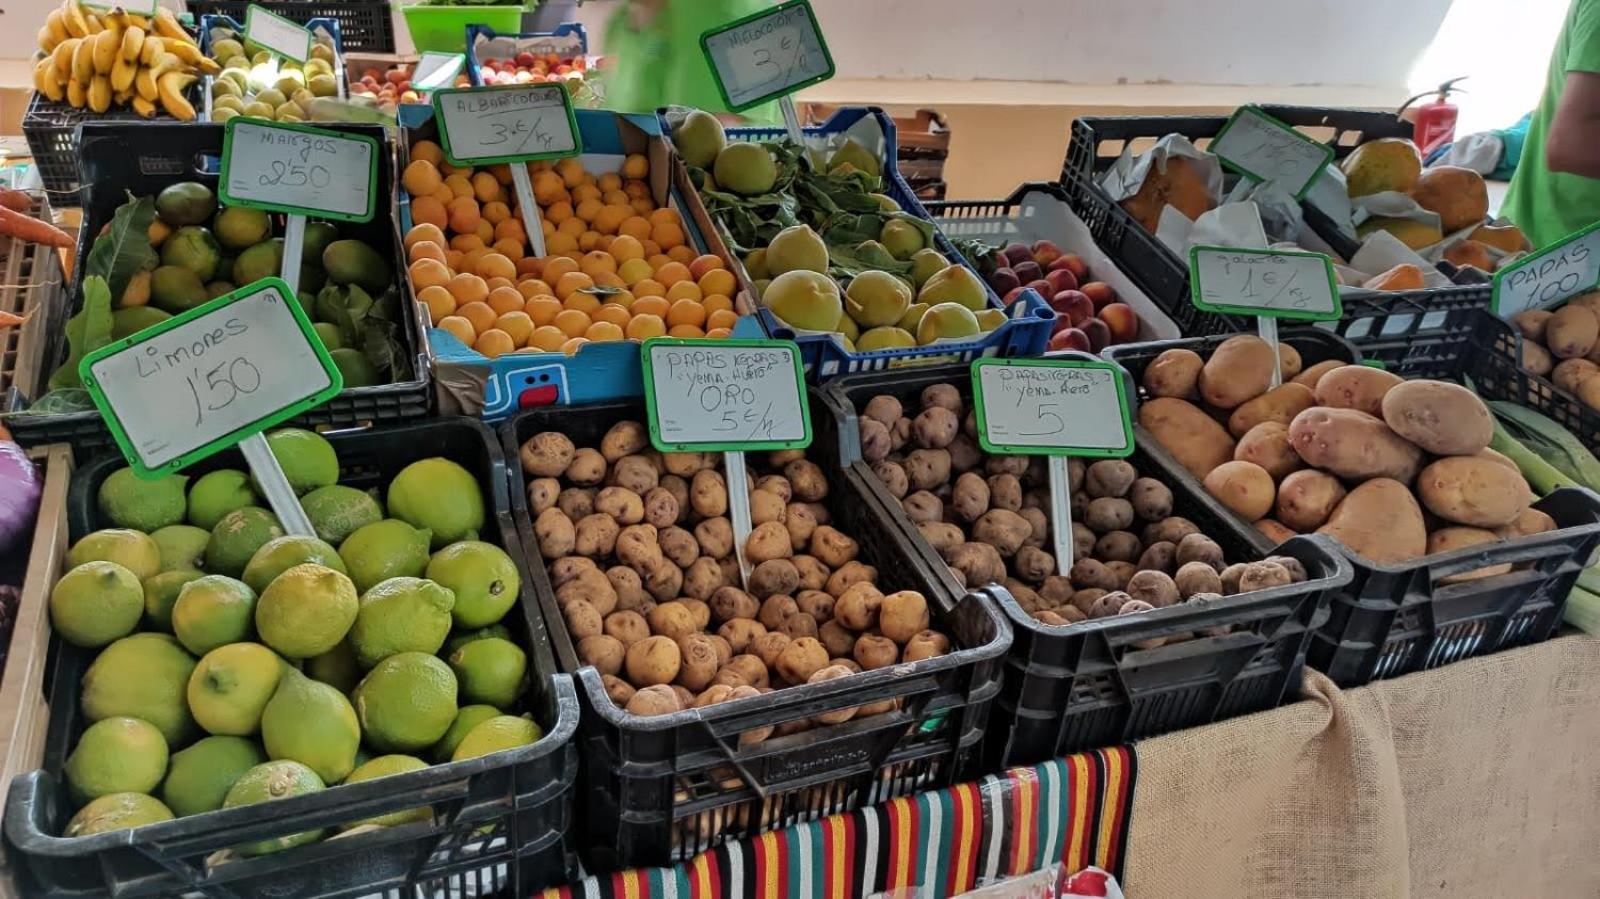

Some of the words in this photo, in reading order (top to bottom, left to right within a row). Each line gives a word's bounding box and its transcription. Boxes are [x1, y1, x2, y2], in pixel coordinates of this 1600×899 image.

[1507, 243, 1590, 291] PAPAS
[136, 317, 249, 378] Limones
[666, 351, 727, 378] PAPAS
[700, 383, 755, 412] ORO
[1018, 403, 1065, 436] 5
